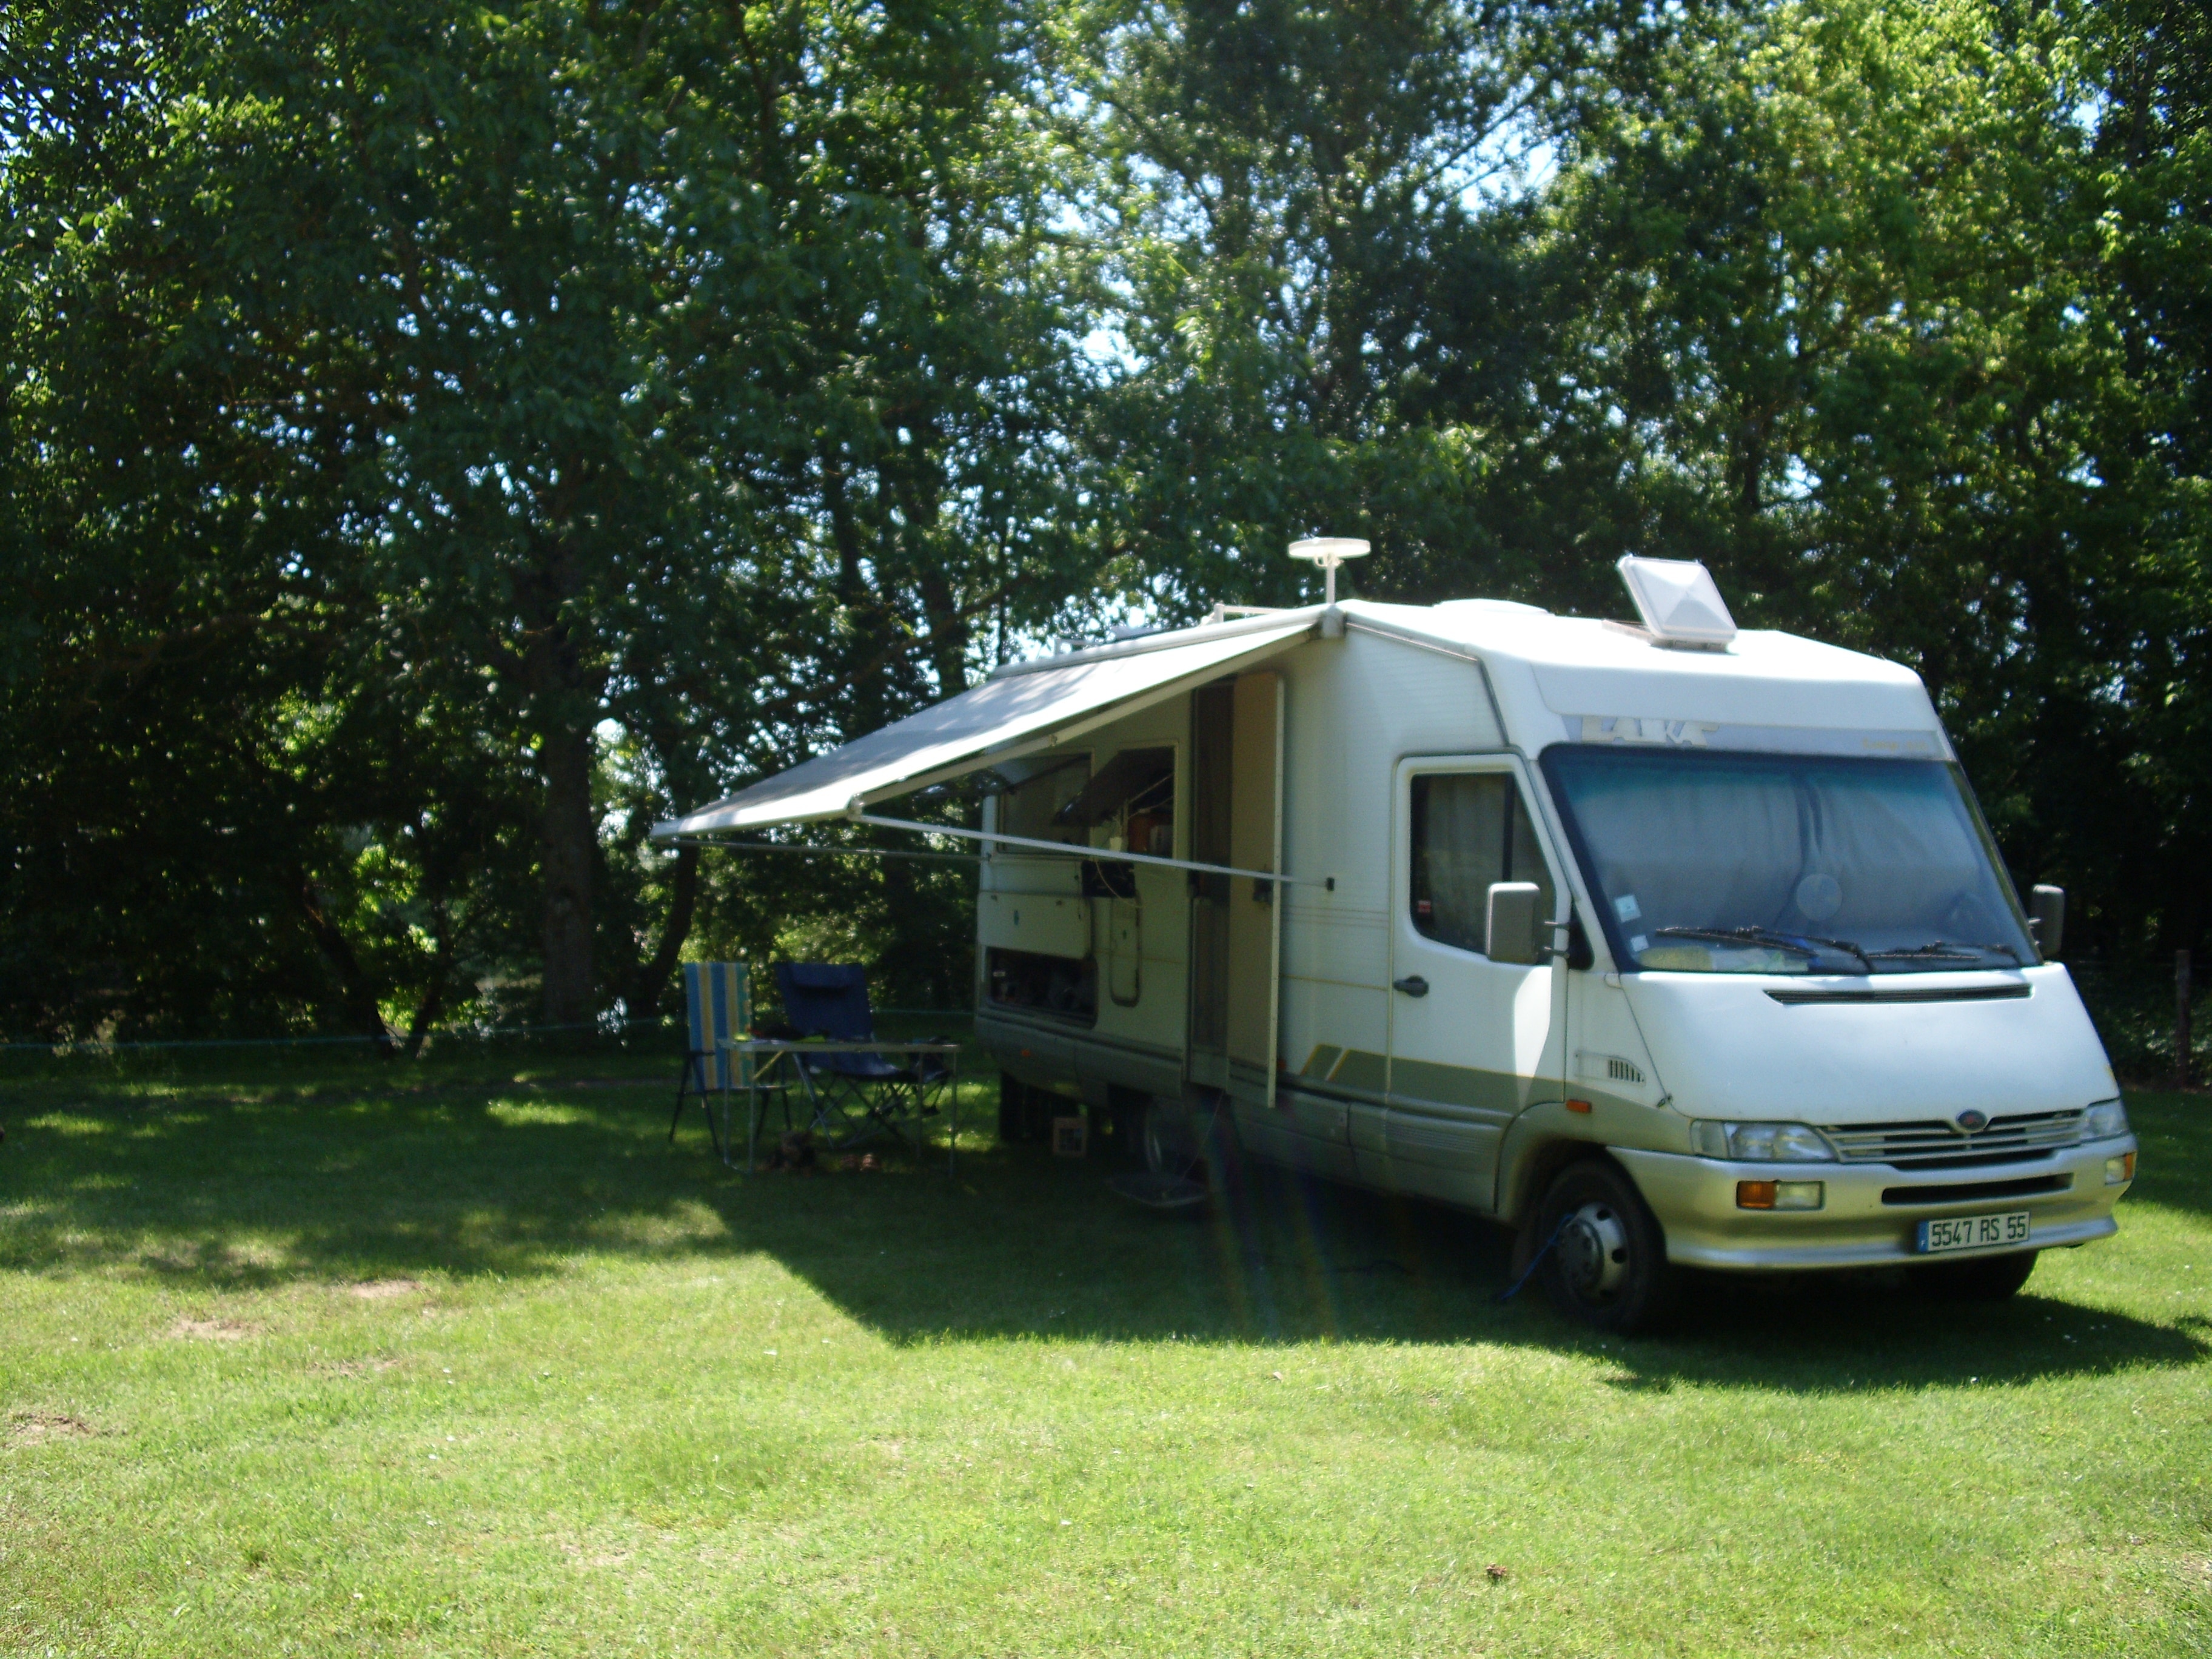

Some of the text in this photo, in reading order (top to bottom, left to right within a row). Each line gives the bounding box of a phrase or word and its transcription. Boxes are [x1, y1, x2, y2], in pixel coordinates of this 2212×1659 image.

[1582, 716, 1720, 747] LAIKA
[1932, 1215, 2026, 1247] 5547 RS 55
